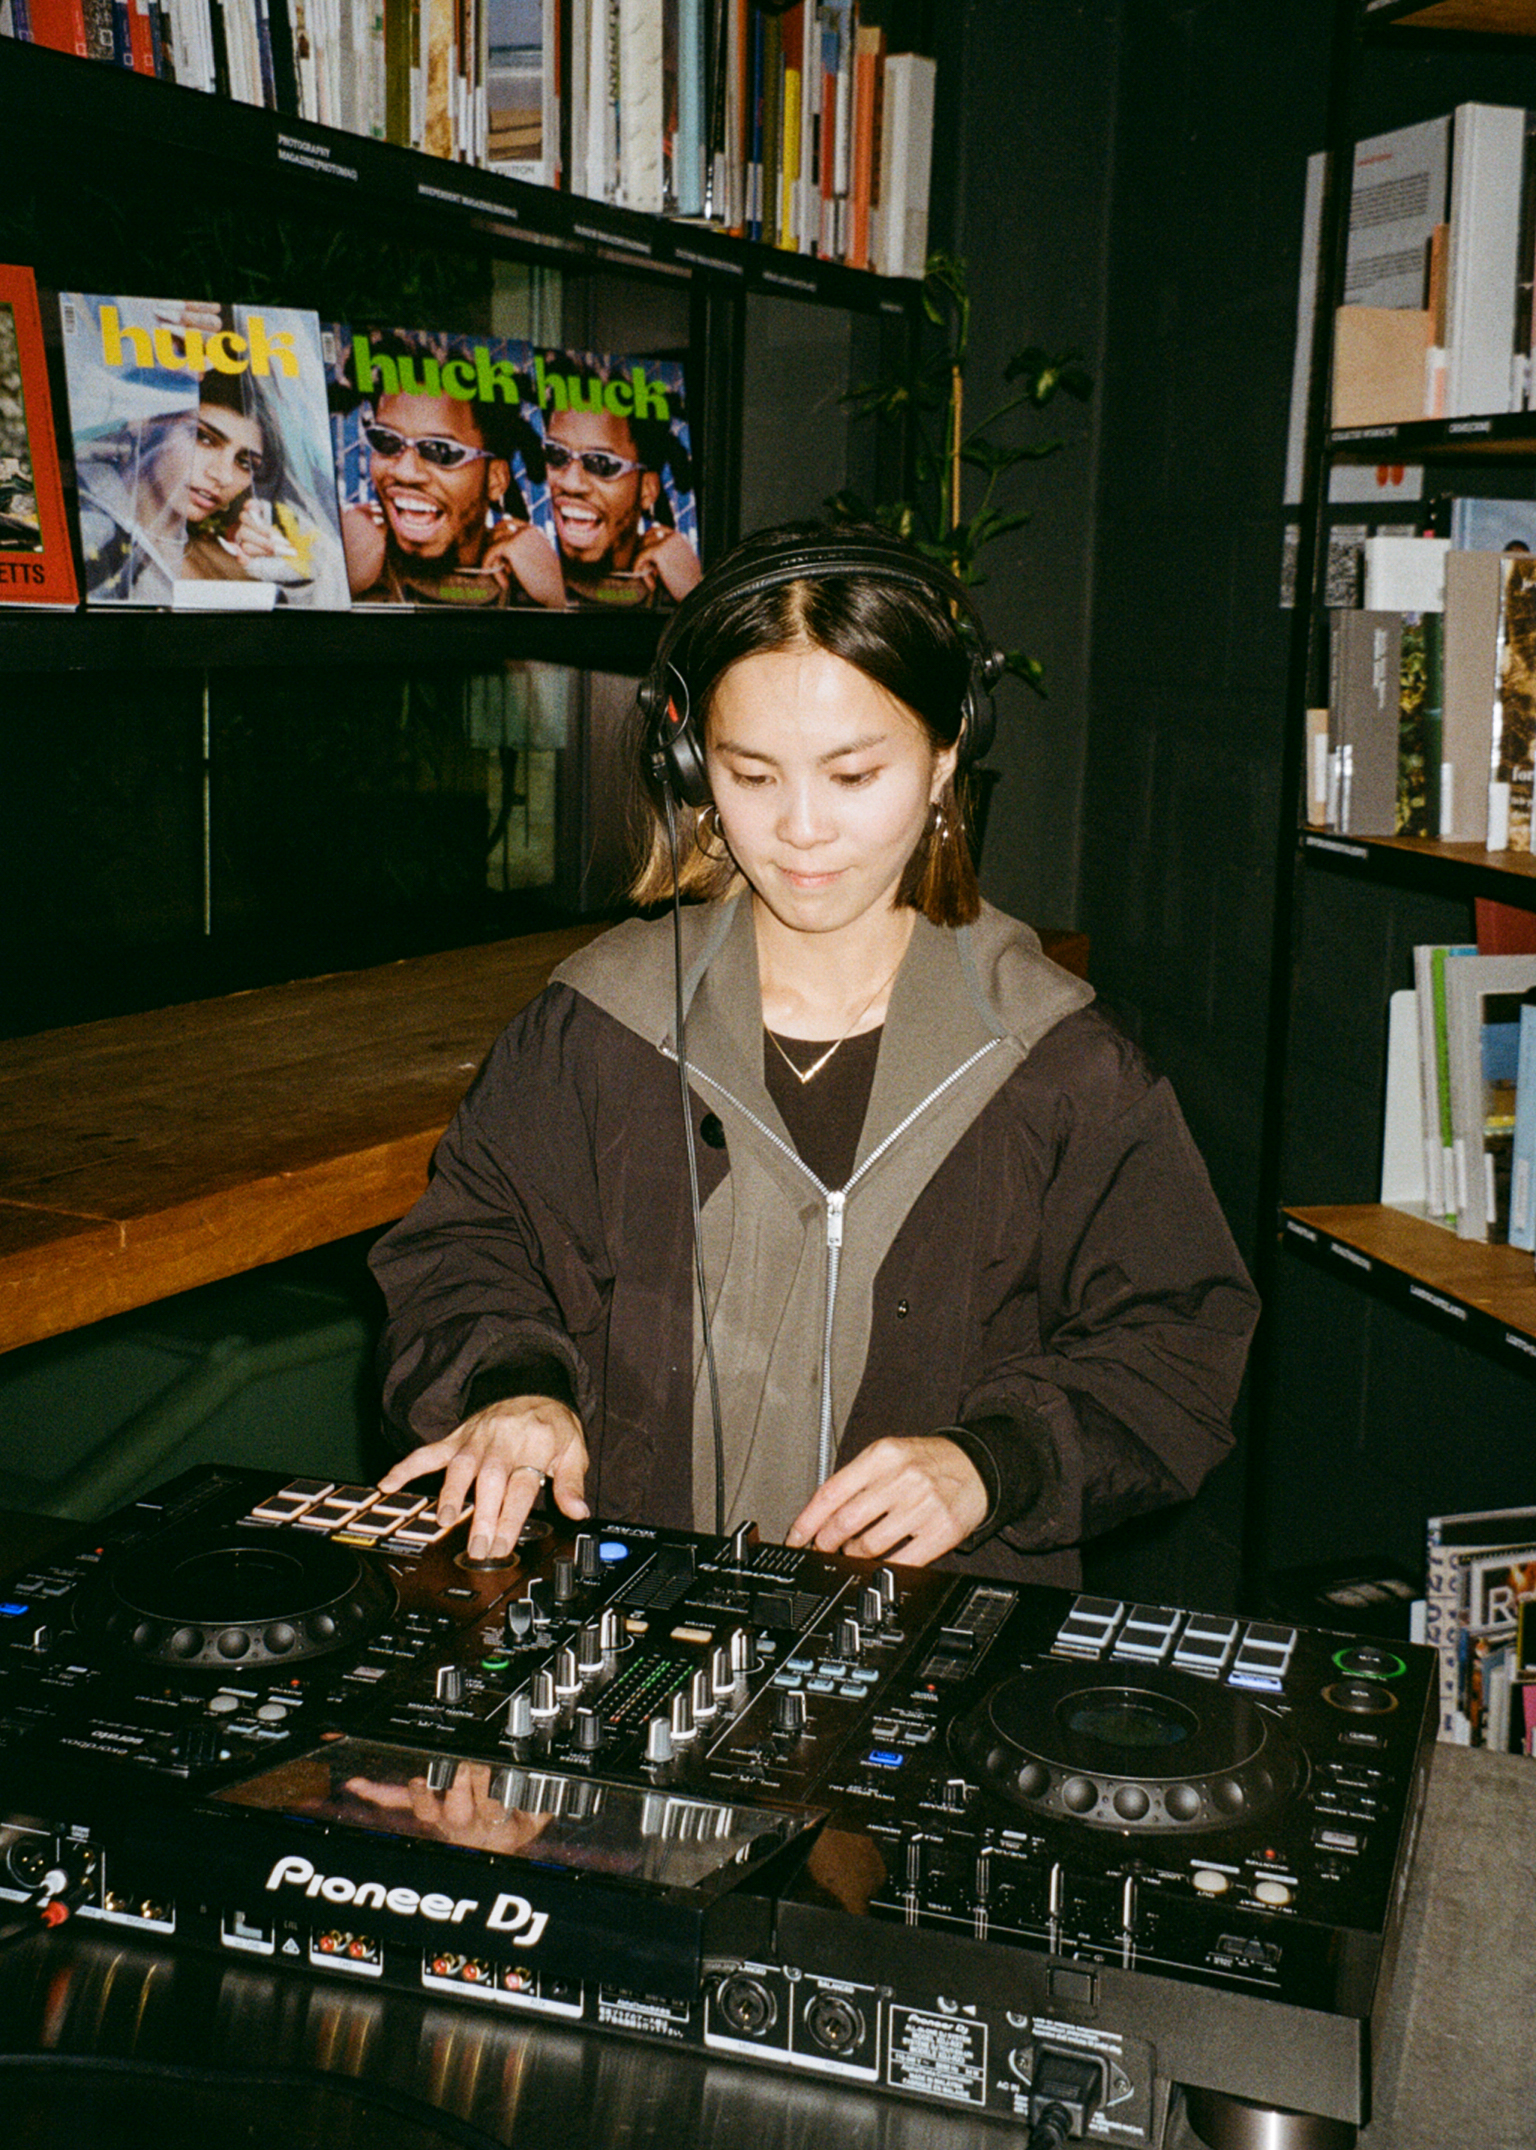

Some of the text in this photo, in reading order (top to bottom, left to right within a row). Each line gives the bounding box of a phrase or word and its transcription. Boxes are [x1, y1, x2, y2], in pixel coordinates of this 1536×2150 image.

[99, 305, 299, 377] huck
[353, 335, 520, 404] huck
[535, 355, 670, 421] huck
[60, 1738, 129, 1756] ekordbox
[265, 1855, 550, 1947] Pioneer DJ
